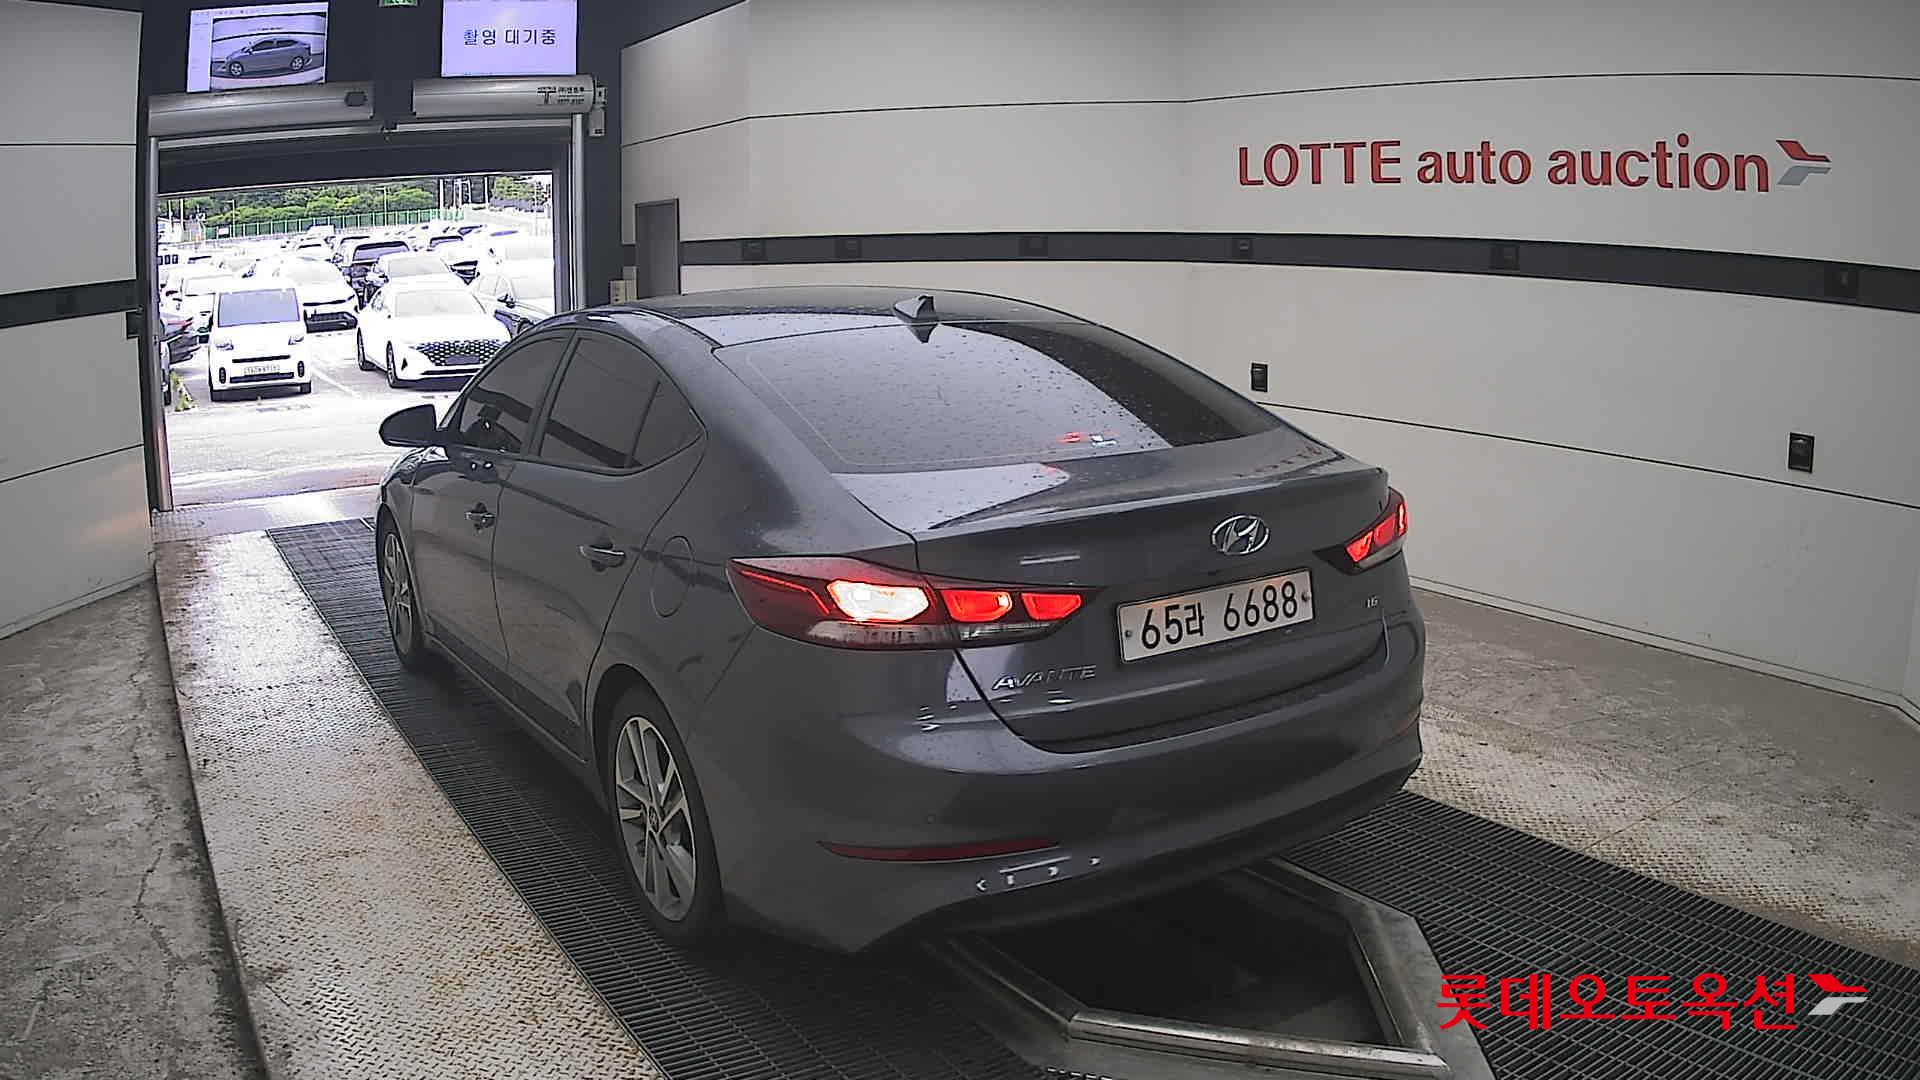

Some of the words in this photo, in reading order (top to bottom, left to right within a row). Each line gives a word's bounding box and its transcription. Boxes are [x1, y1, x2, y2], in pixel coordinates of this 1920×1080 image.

[504, 28, 557, 46] 대기중
[1239, 140, 1401, 187] LOTTE
[1416, 141, 1532, 185] auto
[1547, 133, 1770, 193] auction
[1141, 602, 1205, 650] 65라
[1223, 580, 1298, 632] 6688
[991, 664, 1097, 690] AVANTE
